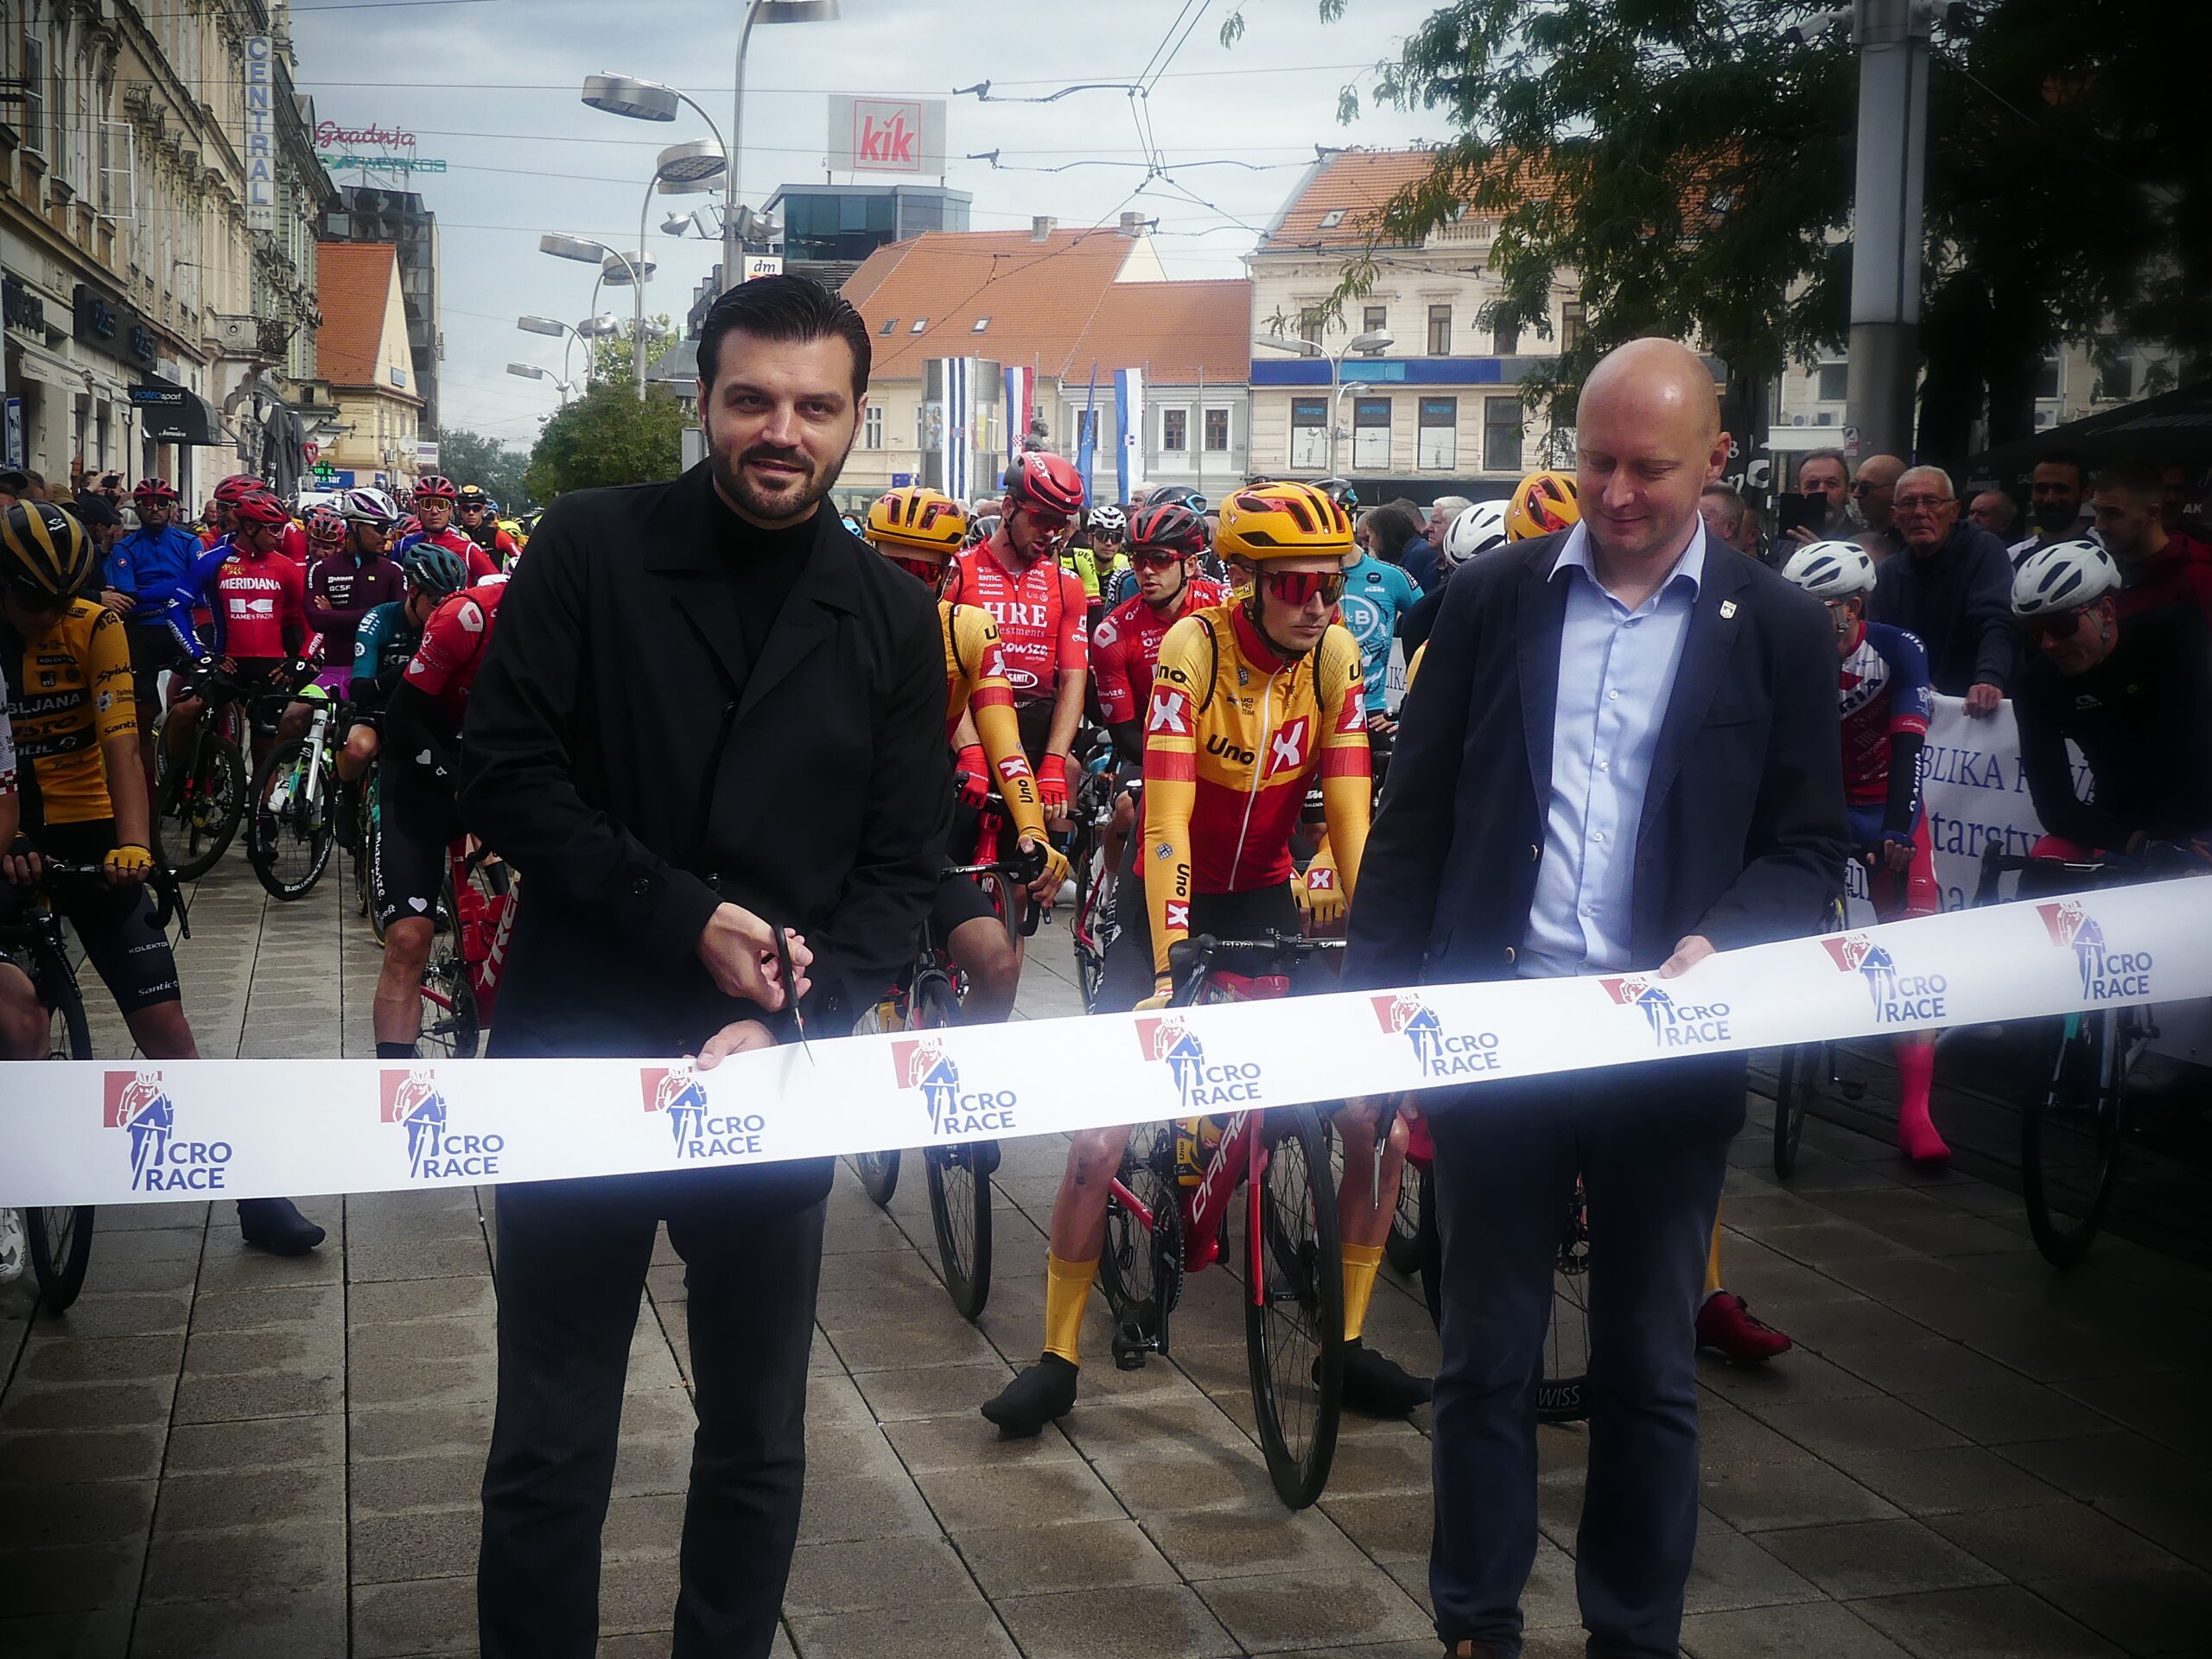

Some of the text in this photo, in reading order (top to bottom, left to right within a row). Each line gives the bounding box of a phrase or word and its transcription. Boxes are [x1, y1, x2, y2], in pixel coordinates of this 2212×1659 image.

[248, 37, 270, 204] CENTRAL
[315, 120, 416, 150] Gradnja
[861, 109, 914, 162] kik
[753, 258, 776, 274] dm
[219, 578, 282, 590] MERIDIANA
[1206, 734, 1255, 766] Uno
[1018, 779, 1033, 804] Uno
[1177, 863, 1191, 897] Uno
[1223, 940, 1253, 950] PRO
[2105, 951, 2154, 976] CRO
[1897, 974, 1948, 996] CRO
[2092, 976, 2151, 1001] RACE
[1676, 1002, 1731, 1023] CRO
[1885, 997, 1948, 1023] RACE
[1444, 1032, 1499, 1054] CRO
[1664, 1021, 1732, 1047] RACE
[1205, 1062, 1262, 1084] CRO
[1431, 1052, 1501, 1077] RACE
[960, 1090, 1018, 1112] CRO
[1191, 1083, 1263, 1107] RACE
[707, 1114, 766, 1135] CRO
[944, 1110, 1016, 1135] RACE
[168, 1141, 233, 1165] CRO
[443, 1135, 505, 1155] CRO
[689, 1135, 763, 1159] RACE
[145, 1167, 226, 1192] RACE
[423, 1156, 499, 1179] RACE
